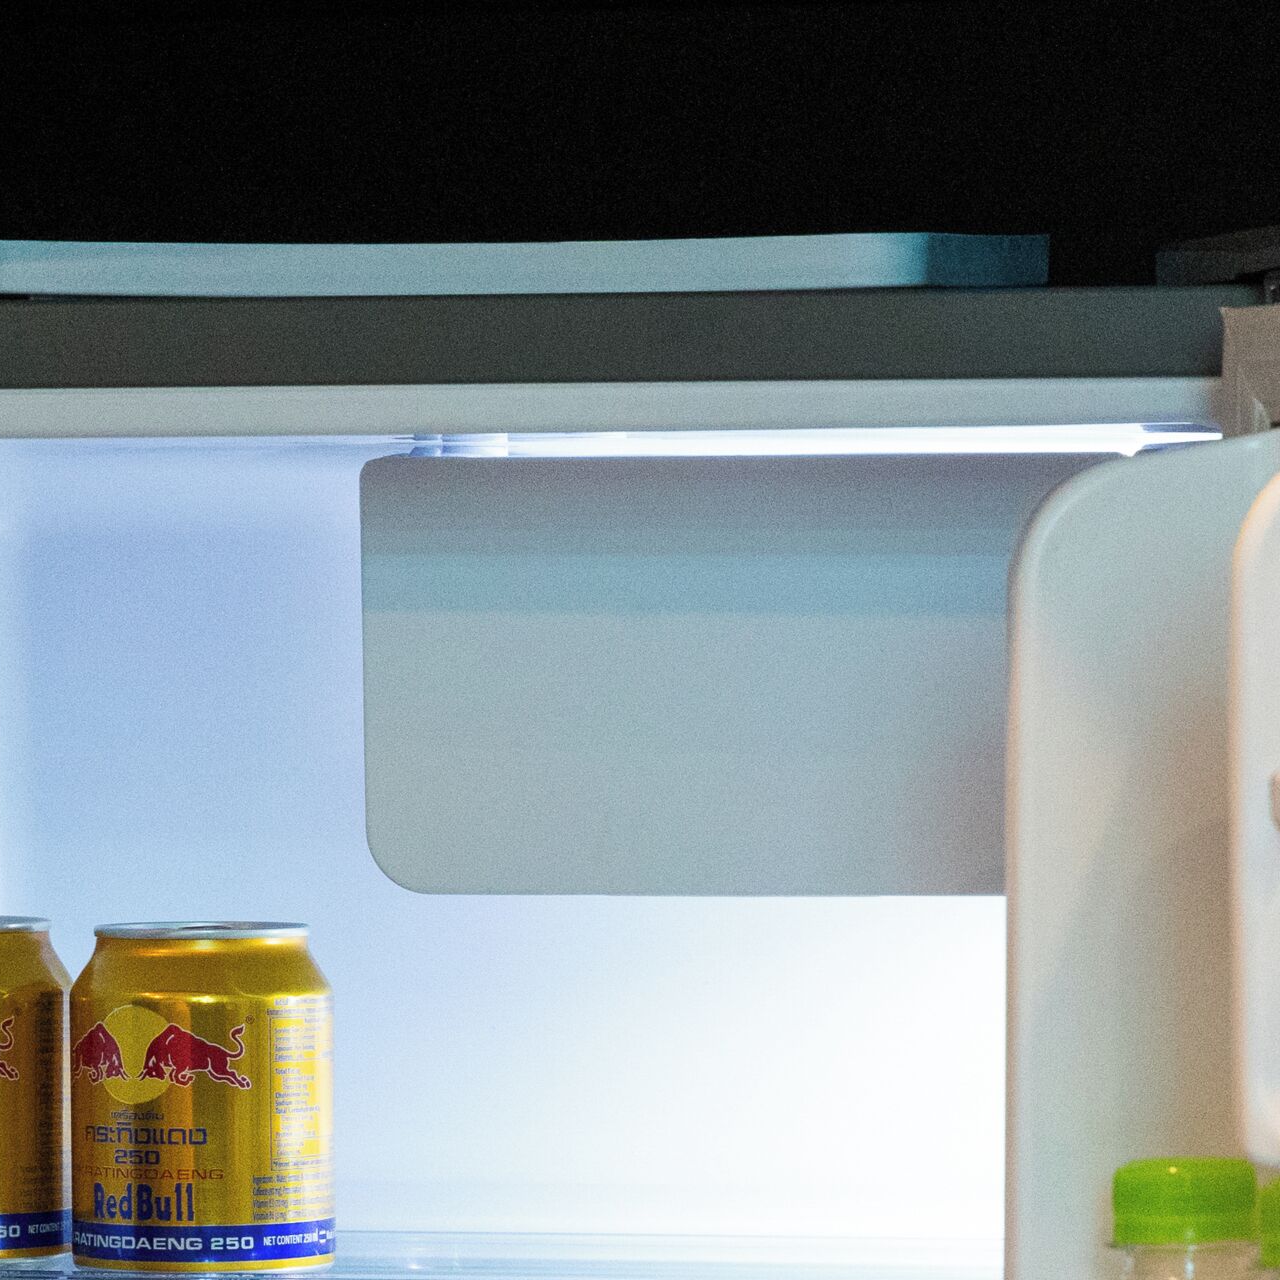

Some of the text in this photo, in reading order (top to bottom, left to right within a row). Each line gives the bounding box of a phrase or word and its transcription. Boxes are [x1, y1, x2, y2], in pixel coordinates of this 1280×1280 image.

[85, 1121, 207, 1145] กระทิงแดง
[115, 1149, 160, 1165] 250
[210, 1236, 254, 1250] 250
[263, 1235, 276, 1246] NET
[276, 1234, 303, 1245] CONTENT
